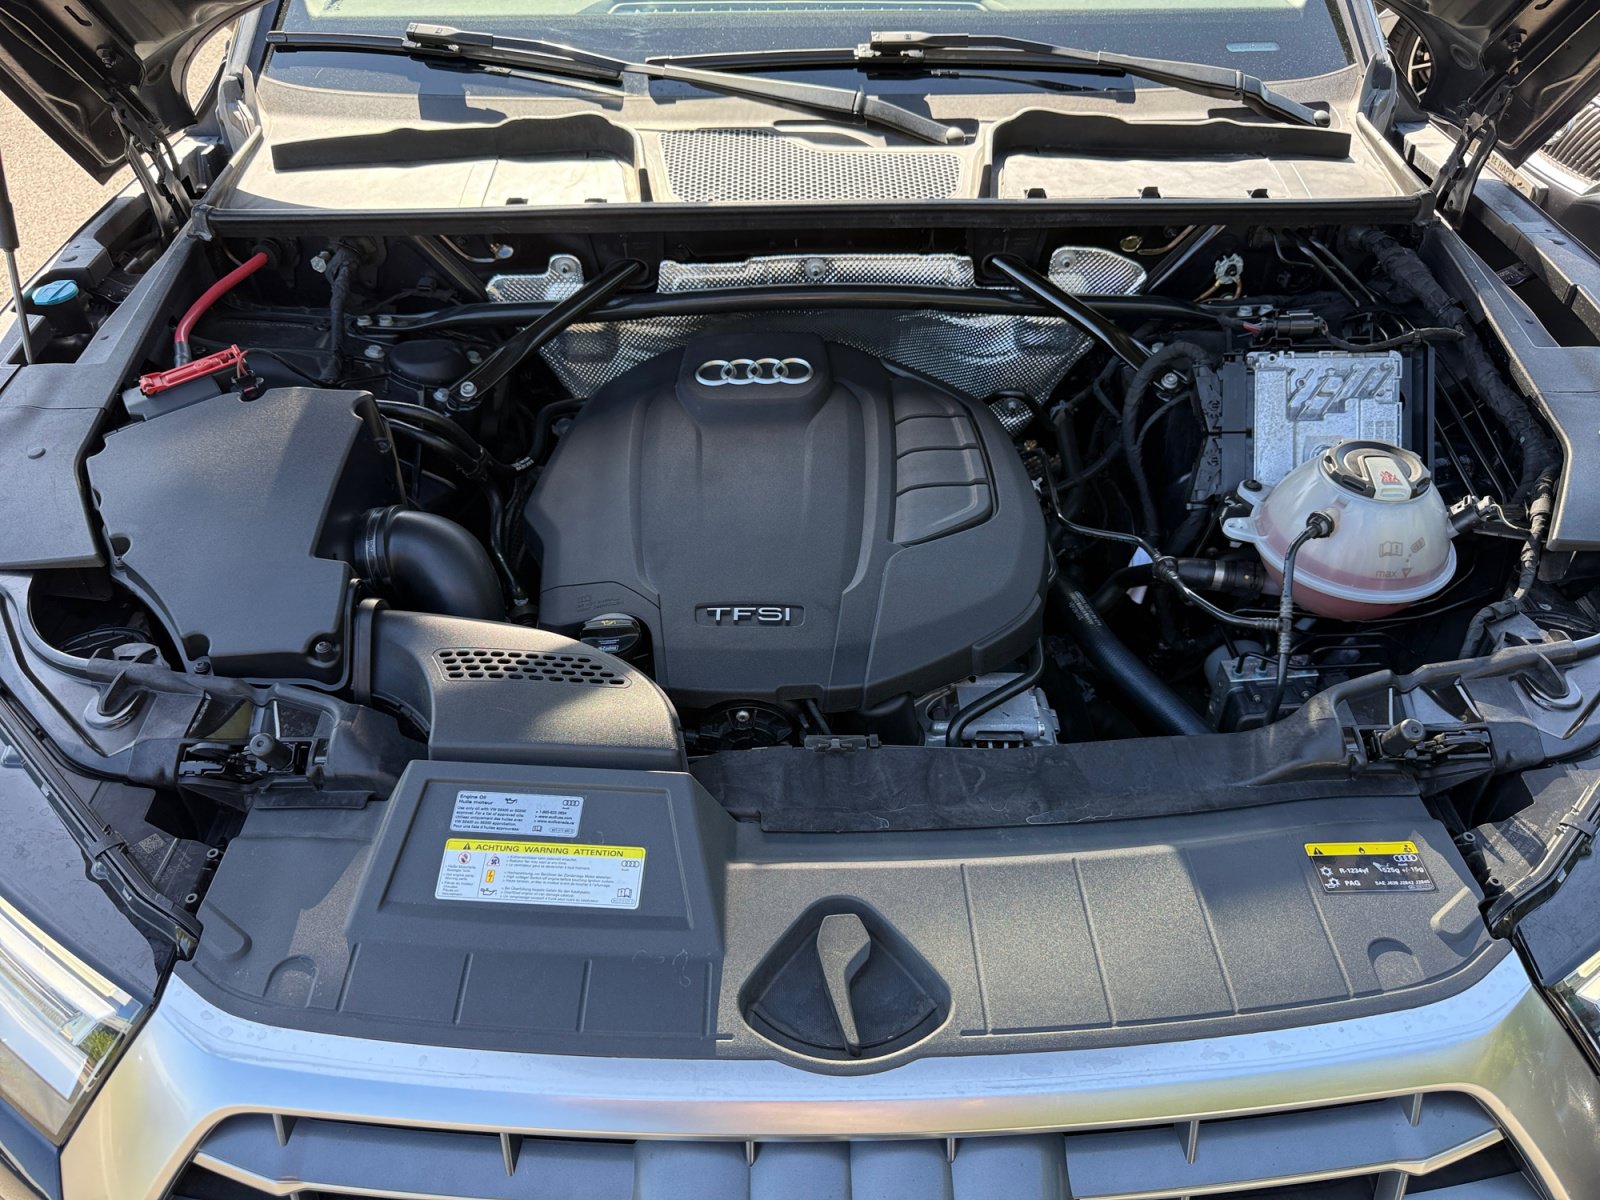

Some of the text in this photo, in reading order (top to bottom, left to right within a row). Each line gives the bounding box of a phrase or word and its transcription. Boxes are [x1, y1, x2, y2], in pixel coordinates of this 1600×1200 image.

[1498, 160, 1517, 181] HAPPY
[1376, 570, 1398, 578] max
[706, 607, 791, 621] TFSI
[476, 844, 624, 857] ACHTUNG WARNING ATTENTION
